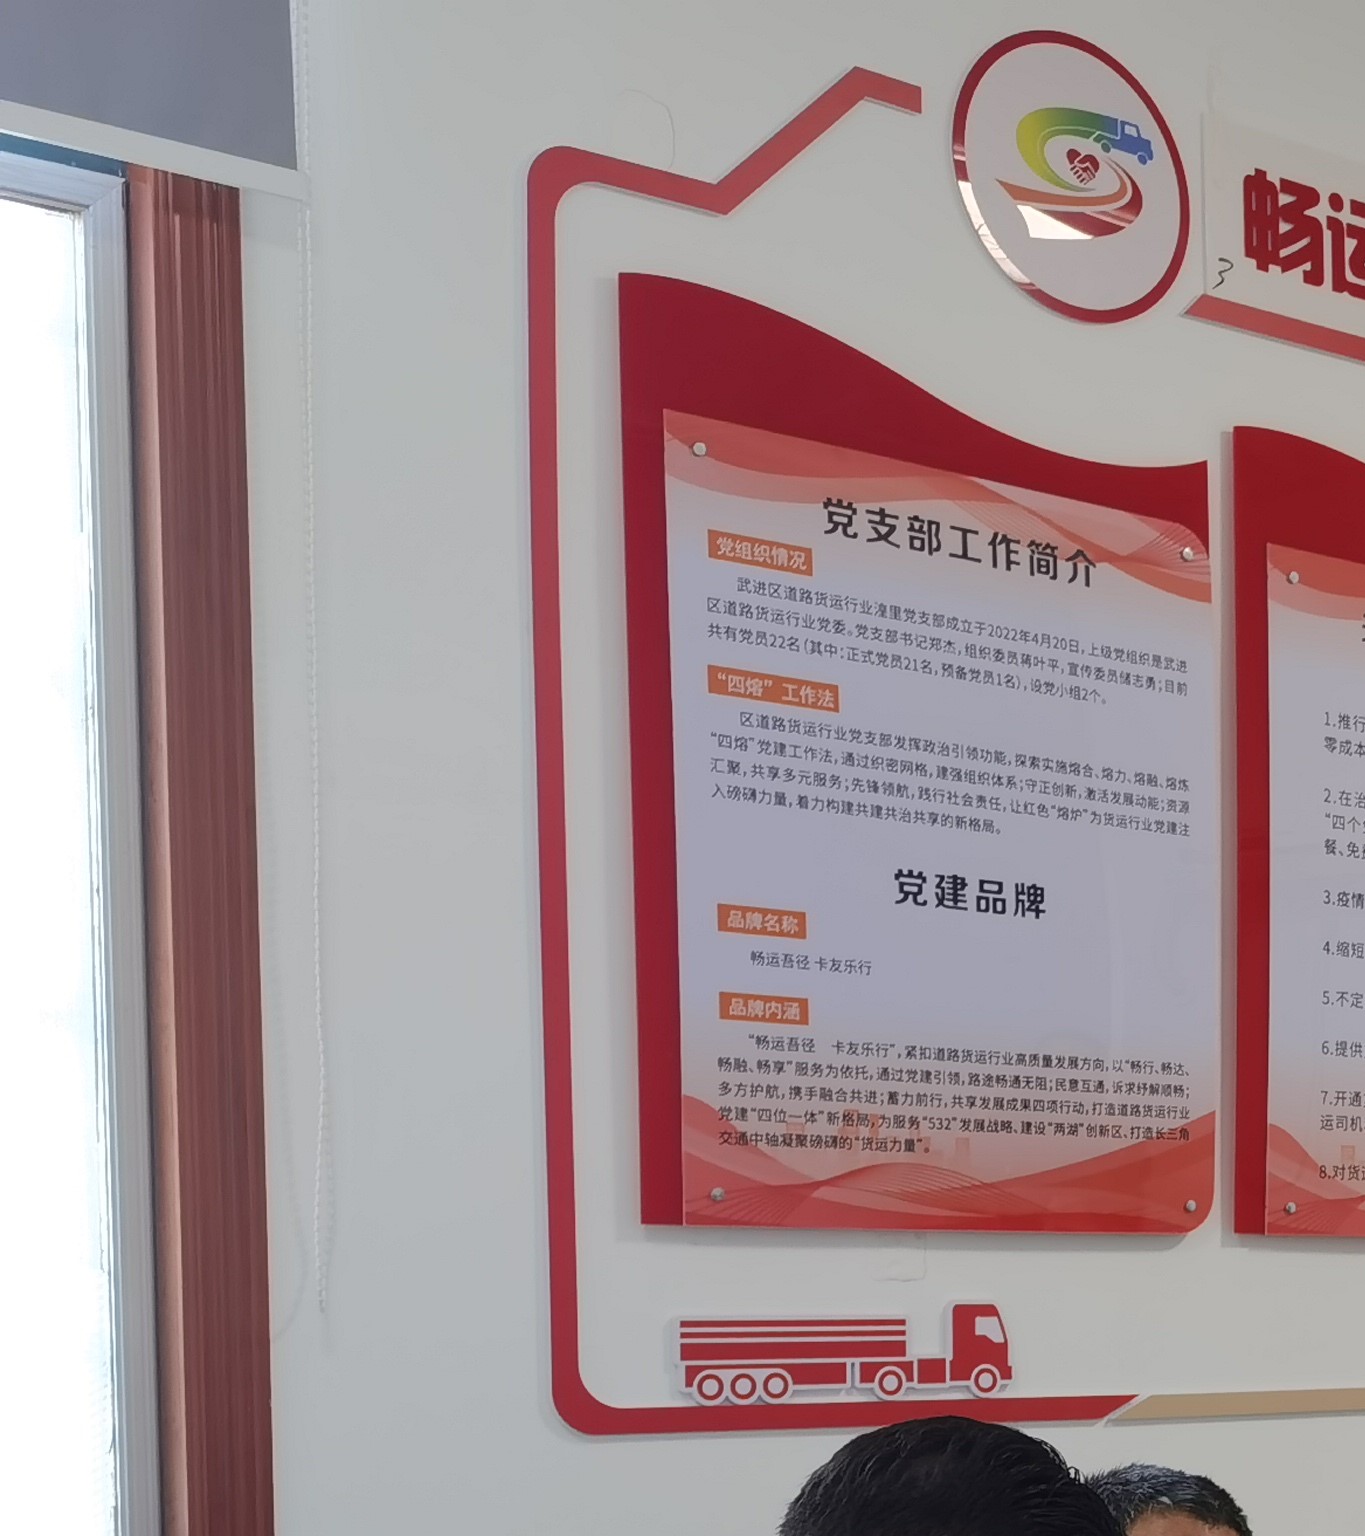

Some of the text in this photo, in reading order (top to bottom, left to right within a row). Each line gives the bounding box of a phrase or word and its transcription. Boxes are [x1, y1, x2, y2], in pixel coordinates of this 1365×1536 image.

[716, 535, 808, 571] 党组织情况
[822, 496, 1097, 588] 党支部工作简介
[893, 868, 1047, 919] 党建品牌
[727, 909, 799, 936] 品牌名称
[750, 950, 872, 976] 畅运吾径 卡友乐行
[729, 998, 800, 1021] 品牌内涵
